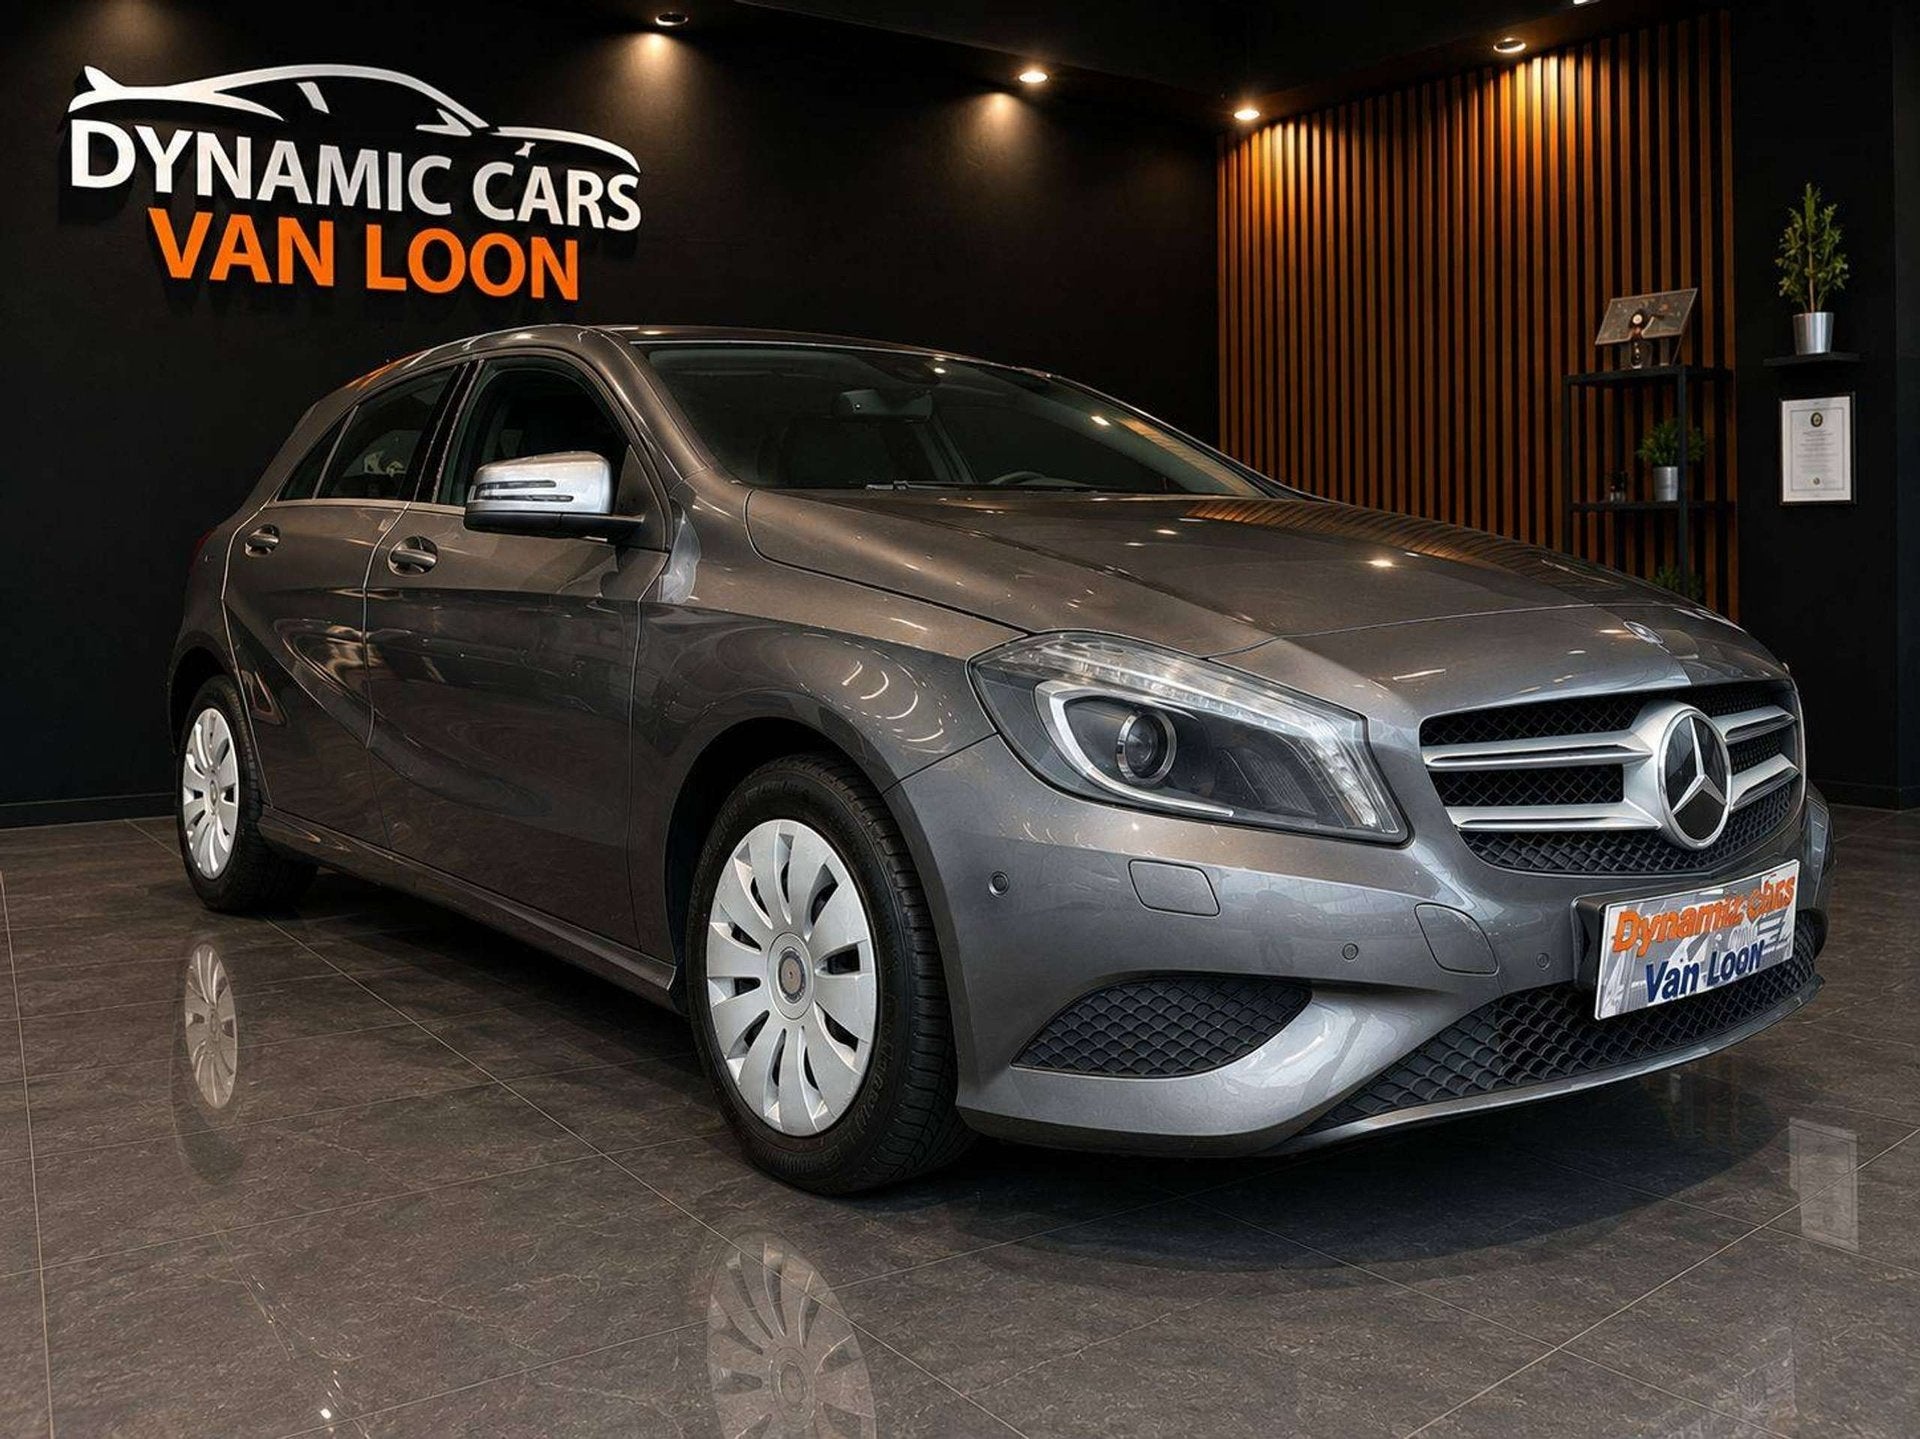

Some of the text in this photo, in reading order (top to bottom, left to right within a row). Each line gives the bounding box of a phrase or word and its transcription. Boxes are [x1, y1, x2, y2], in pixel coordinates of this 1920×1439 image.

[71, 119, 642, 232] DYNAMIC CARS
[147, 208, 578, 301] VAN LOON
[1646, 960, 1700, 1003] Van
